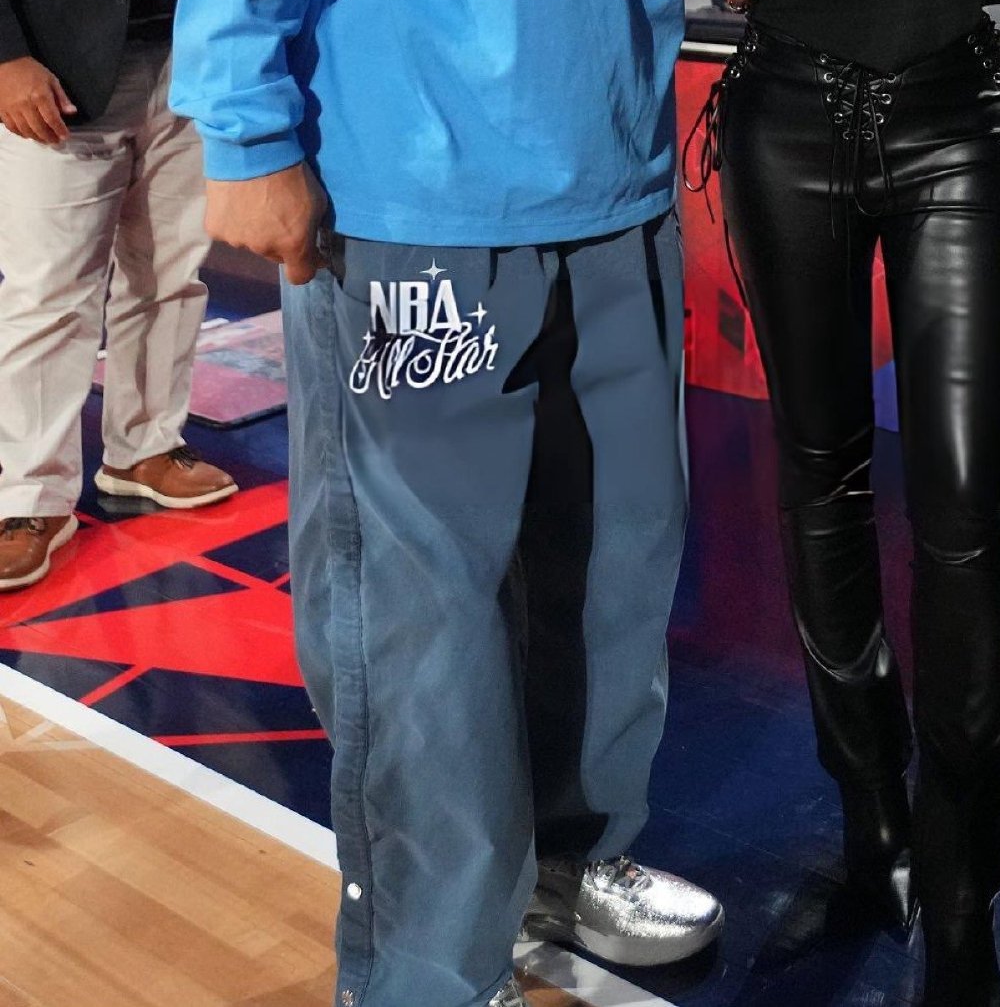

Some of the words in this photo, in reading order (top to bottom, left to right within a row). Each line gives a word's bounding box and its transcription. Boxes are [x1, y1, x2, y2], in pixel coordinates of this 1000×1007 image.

[370, 279, 462, 334] NBA
[350, 334, 415, 399] All
[402, 321, 498, 388] Star
